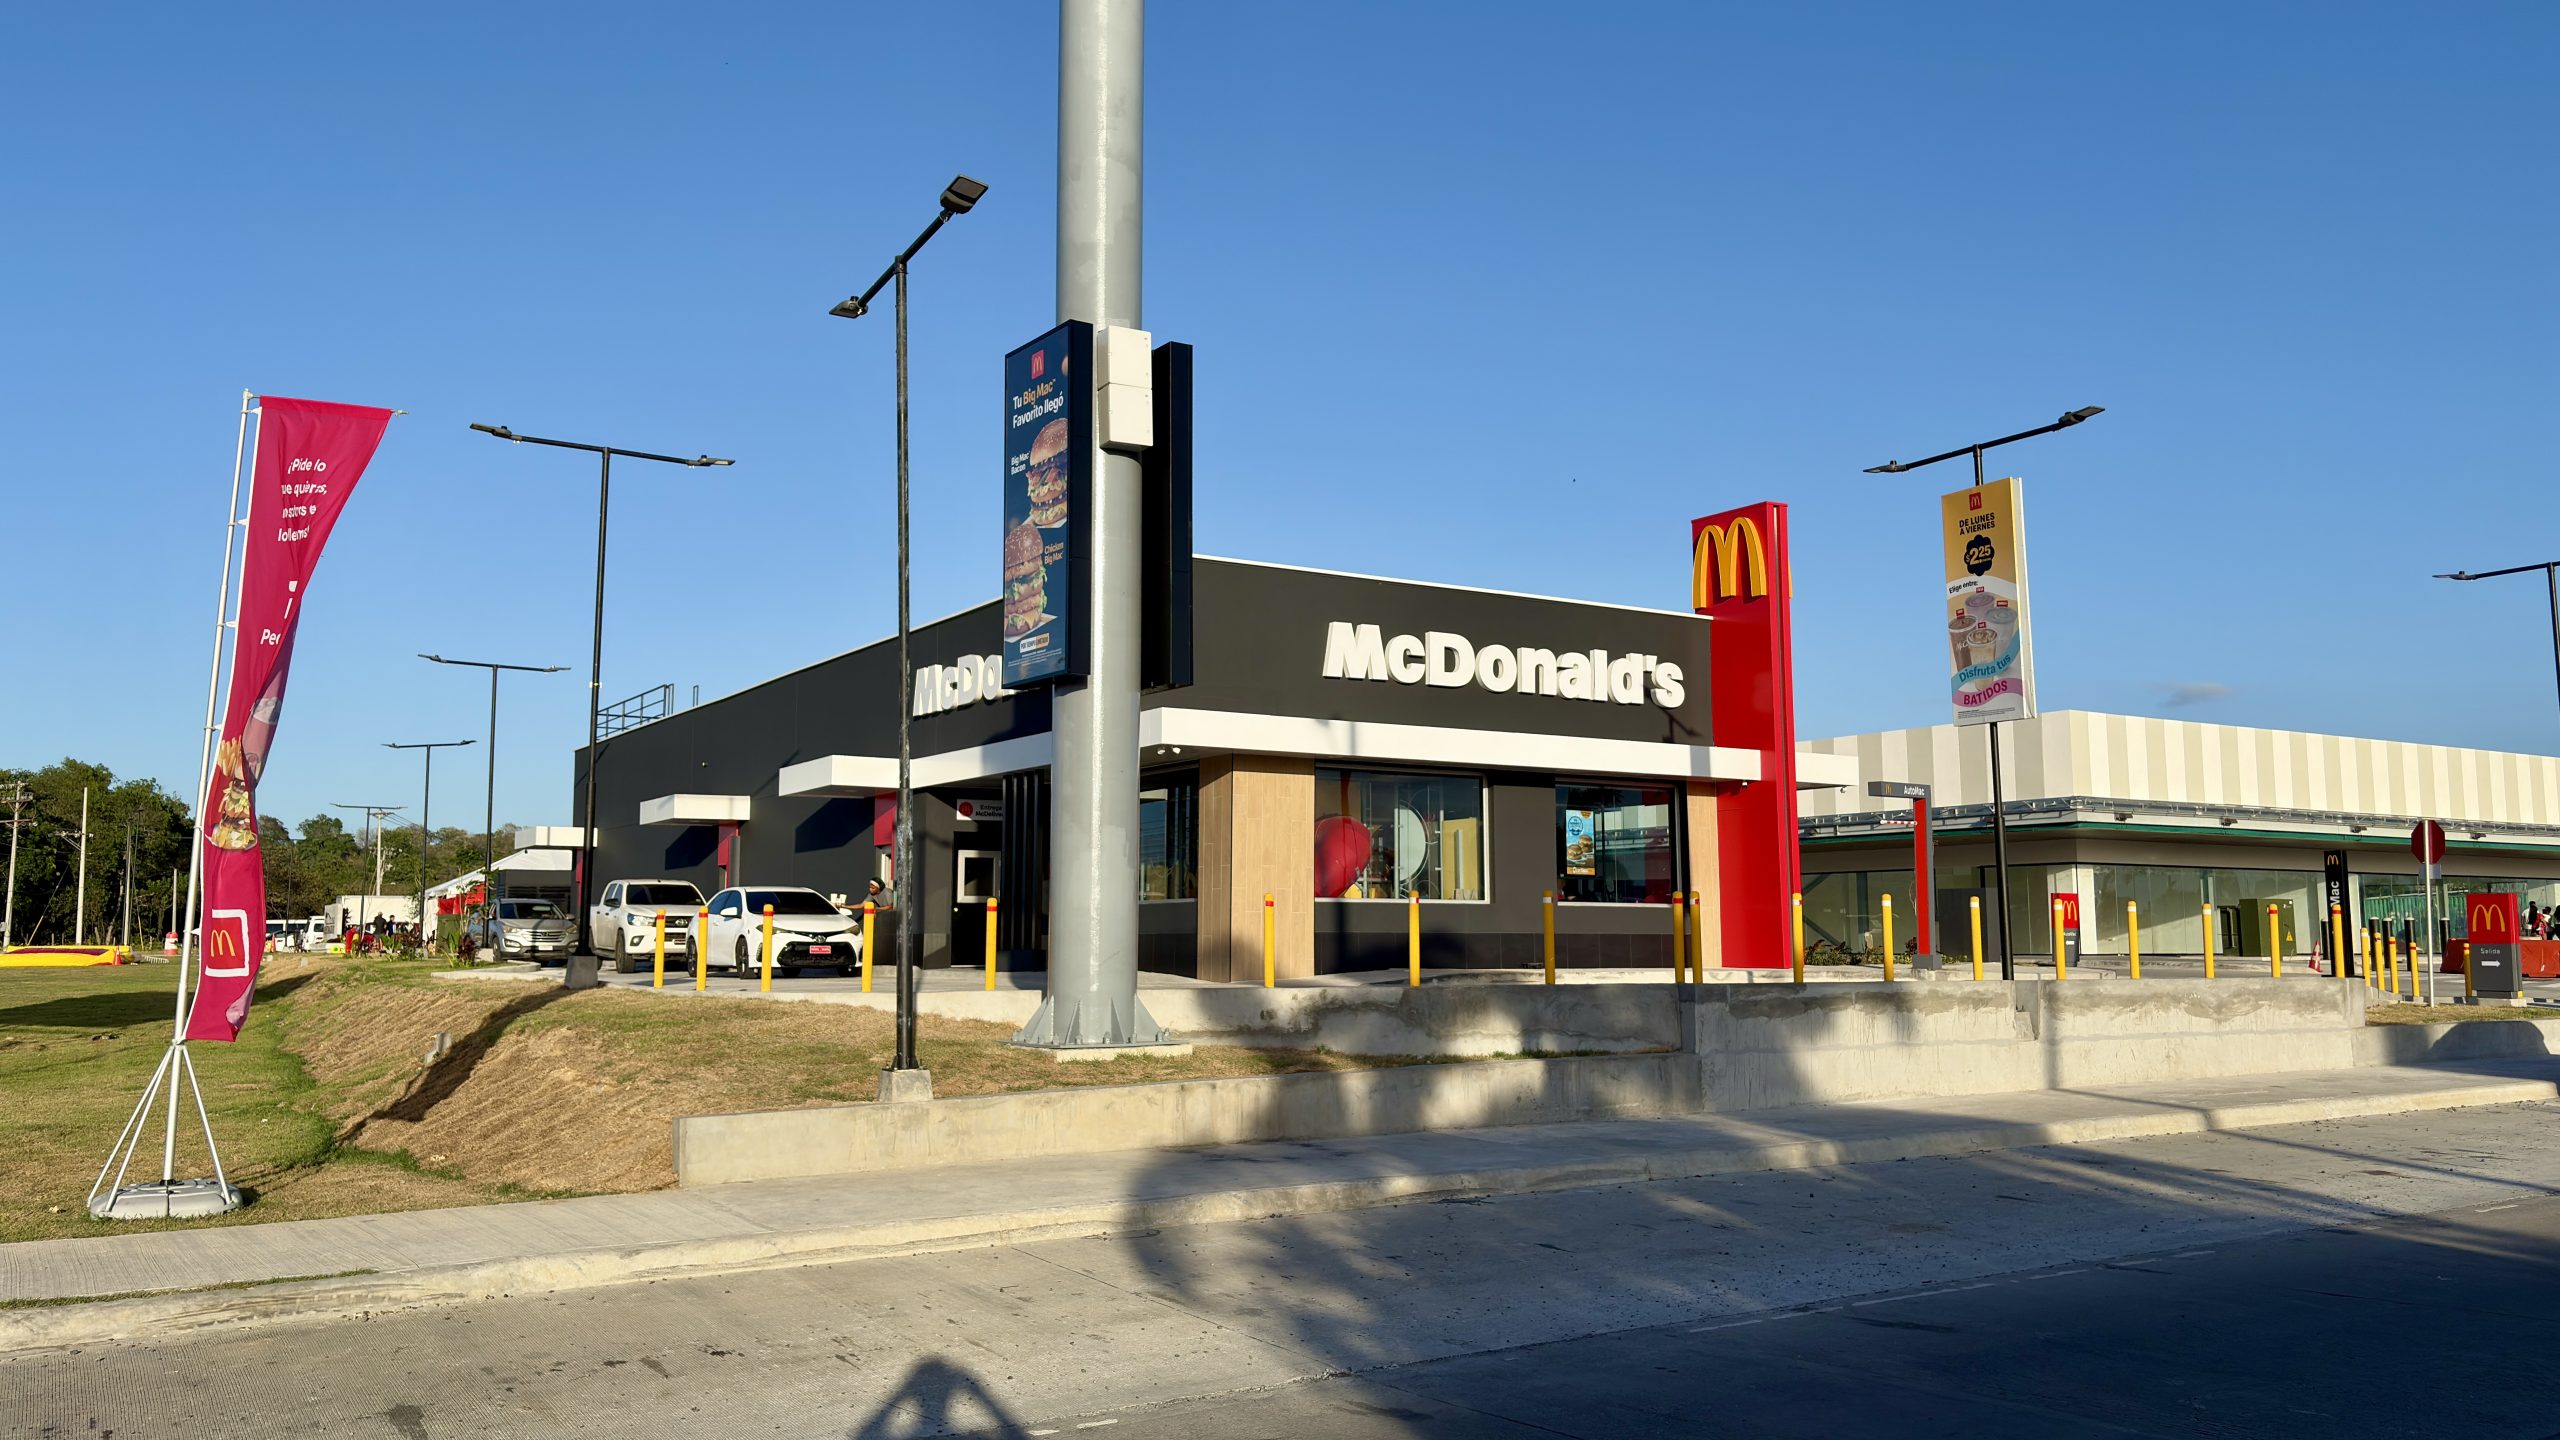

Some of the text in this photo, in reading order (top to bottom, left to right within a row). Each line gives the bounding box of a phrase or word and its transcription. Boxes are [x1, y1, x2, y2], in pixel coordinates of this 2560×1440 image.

[1013, 395, 1022, 410] Tu
[1023, 386, 1036, 405] Big
[1013, 391, 1064, 429] Favorito llegó
[313, 458, 327, 472] lo
[1011, 455, 1019, 466] Big
[281, 484, 292, 495] ue
[1959, 512, 1995, 528] DE LUNES
[1960, 521, 1995, 536] A VIERNES
[1044, 542, 1064, 554] Chicken
[1044, 554, 1053, 566] Big
[1949, 580, 1978, 594] Elige entre:
[1322, 621, 1686, 709] McDonald's
[1960, 654, 2011, 682] Disfruta tus
[1963, 680, 2008, 705] BATIDOS
[2480, 947, 2500, 955] Salida
